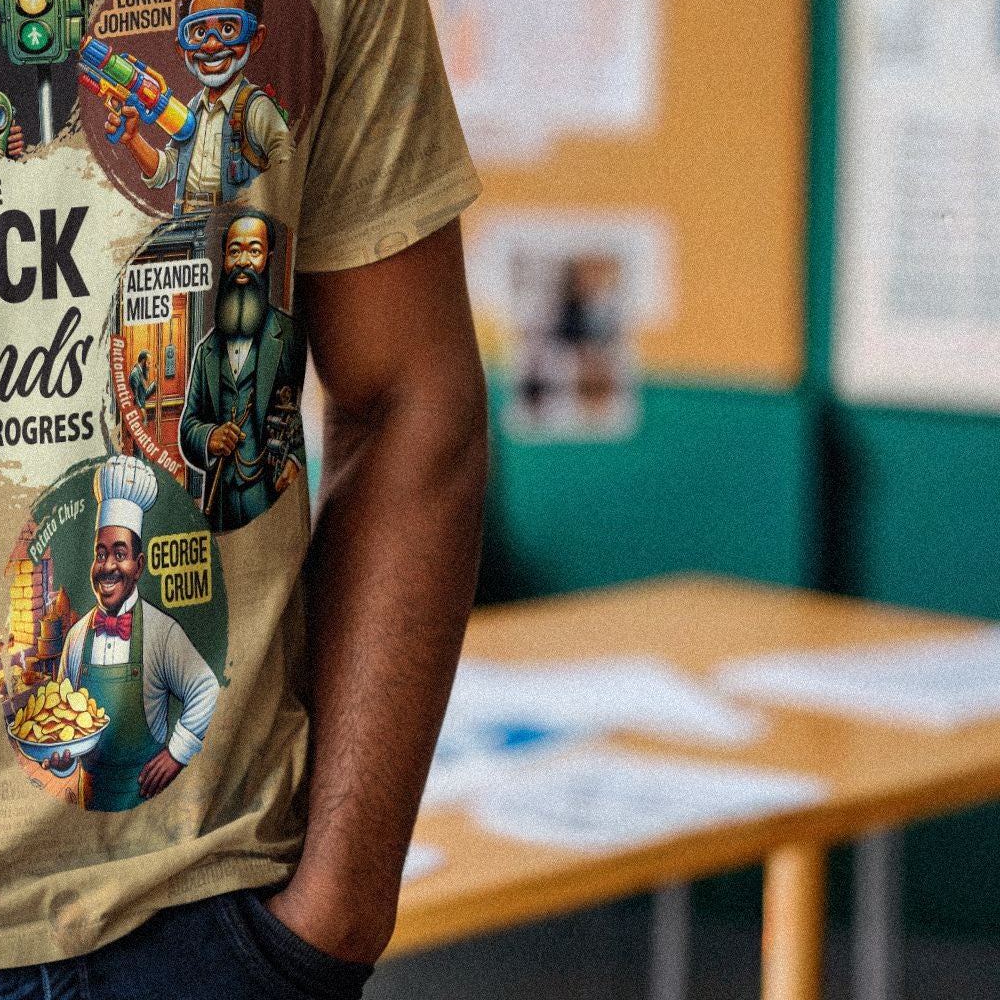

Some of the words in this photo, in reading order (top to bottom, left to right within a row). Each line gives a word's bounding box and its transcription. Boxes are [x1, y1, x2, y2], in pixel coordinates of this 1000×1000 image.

[98, 6, 172, 35] JOHNSON
[126, 262, 210, 294] ALEXANDER
[126, 294, 170, 322] MILES
[112, 338, 133, 411] Automatic
[125, 410, 160, 457] Elevator
[157, 449, 182, 476] Door
[29, 519, 59, 562] Potato
[56, 497, 86, 525] Chips
[151, 536, 208, 570] GEORGE
[164, 569, 209, 603] CRUM
